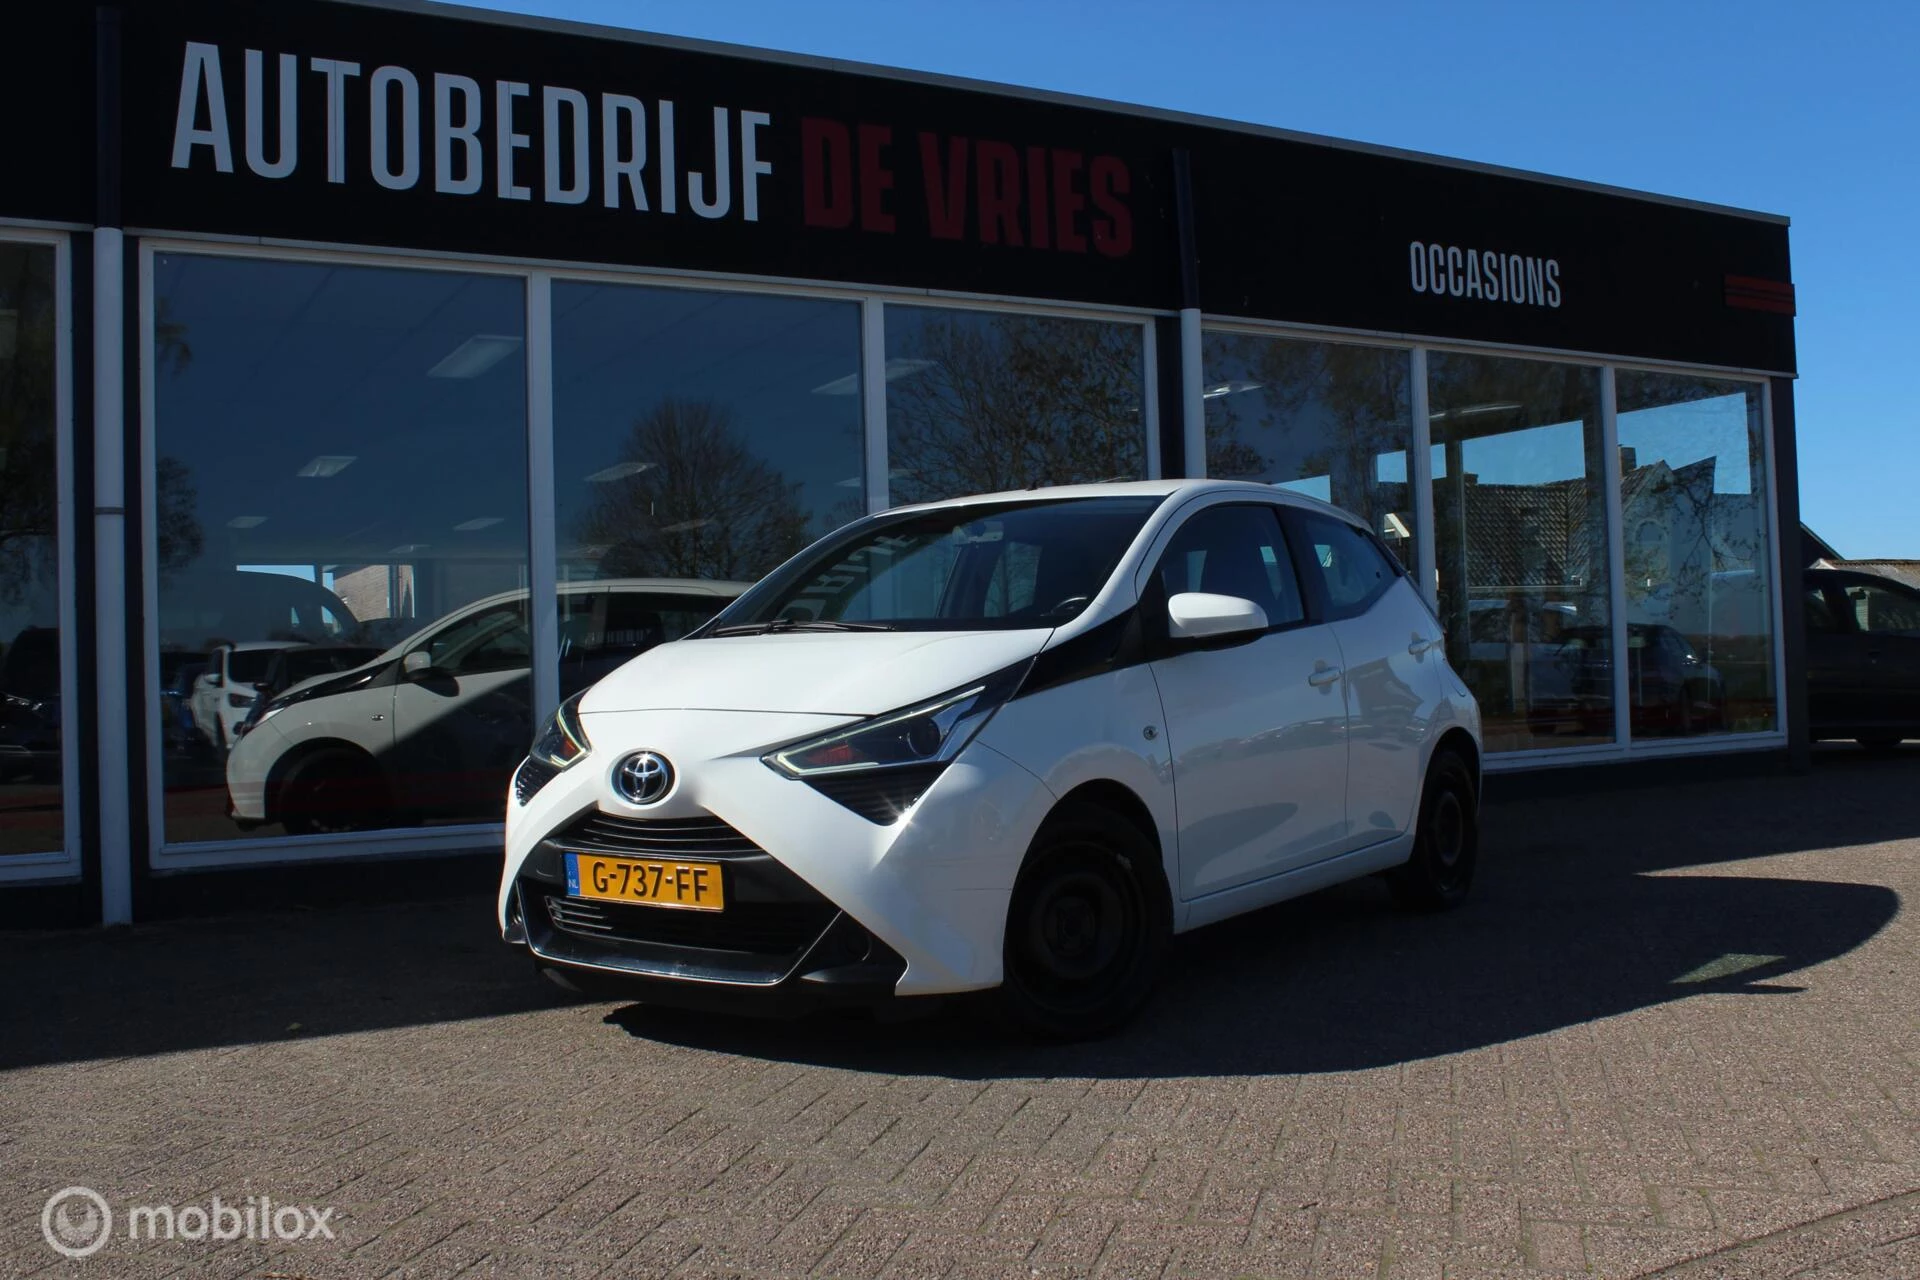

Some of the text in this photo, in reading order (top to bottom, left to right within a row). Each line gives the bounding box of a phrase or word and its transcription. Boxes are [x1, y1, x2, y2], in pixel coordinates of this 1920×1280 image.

[171, 41, 1134, 259] AUTOBEDRIJF DE VRIES
[1410, 241, 1561, 308] OCCASIONS
[593, 861, 708, 901] G-737-FF
